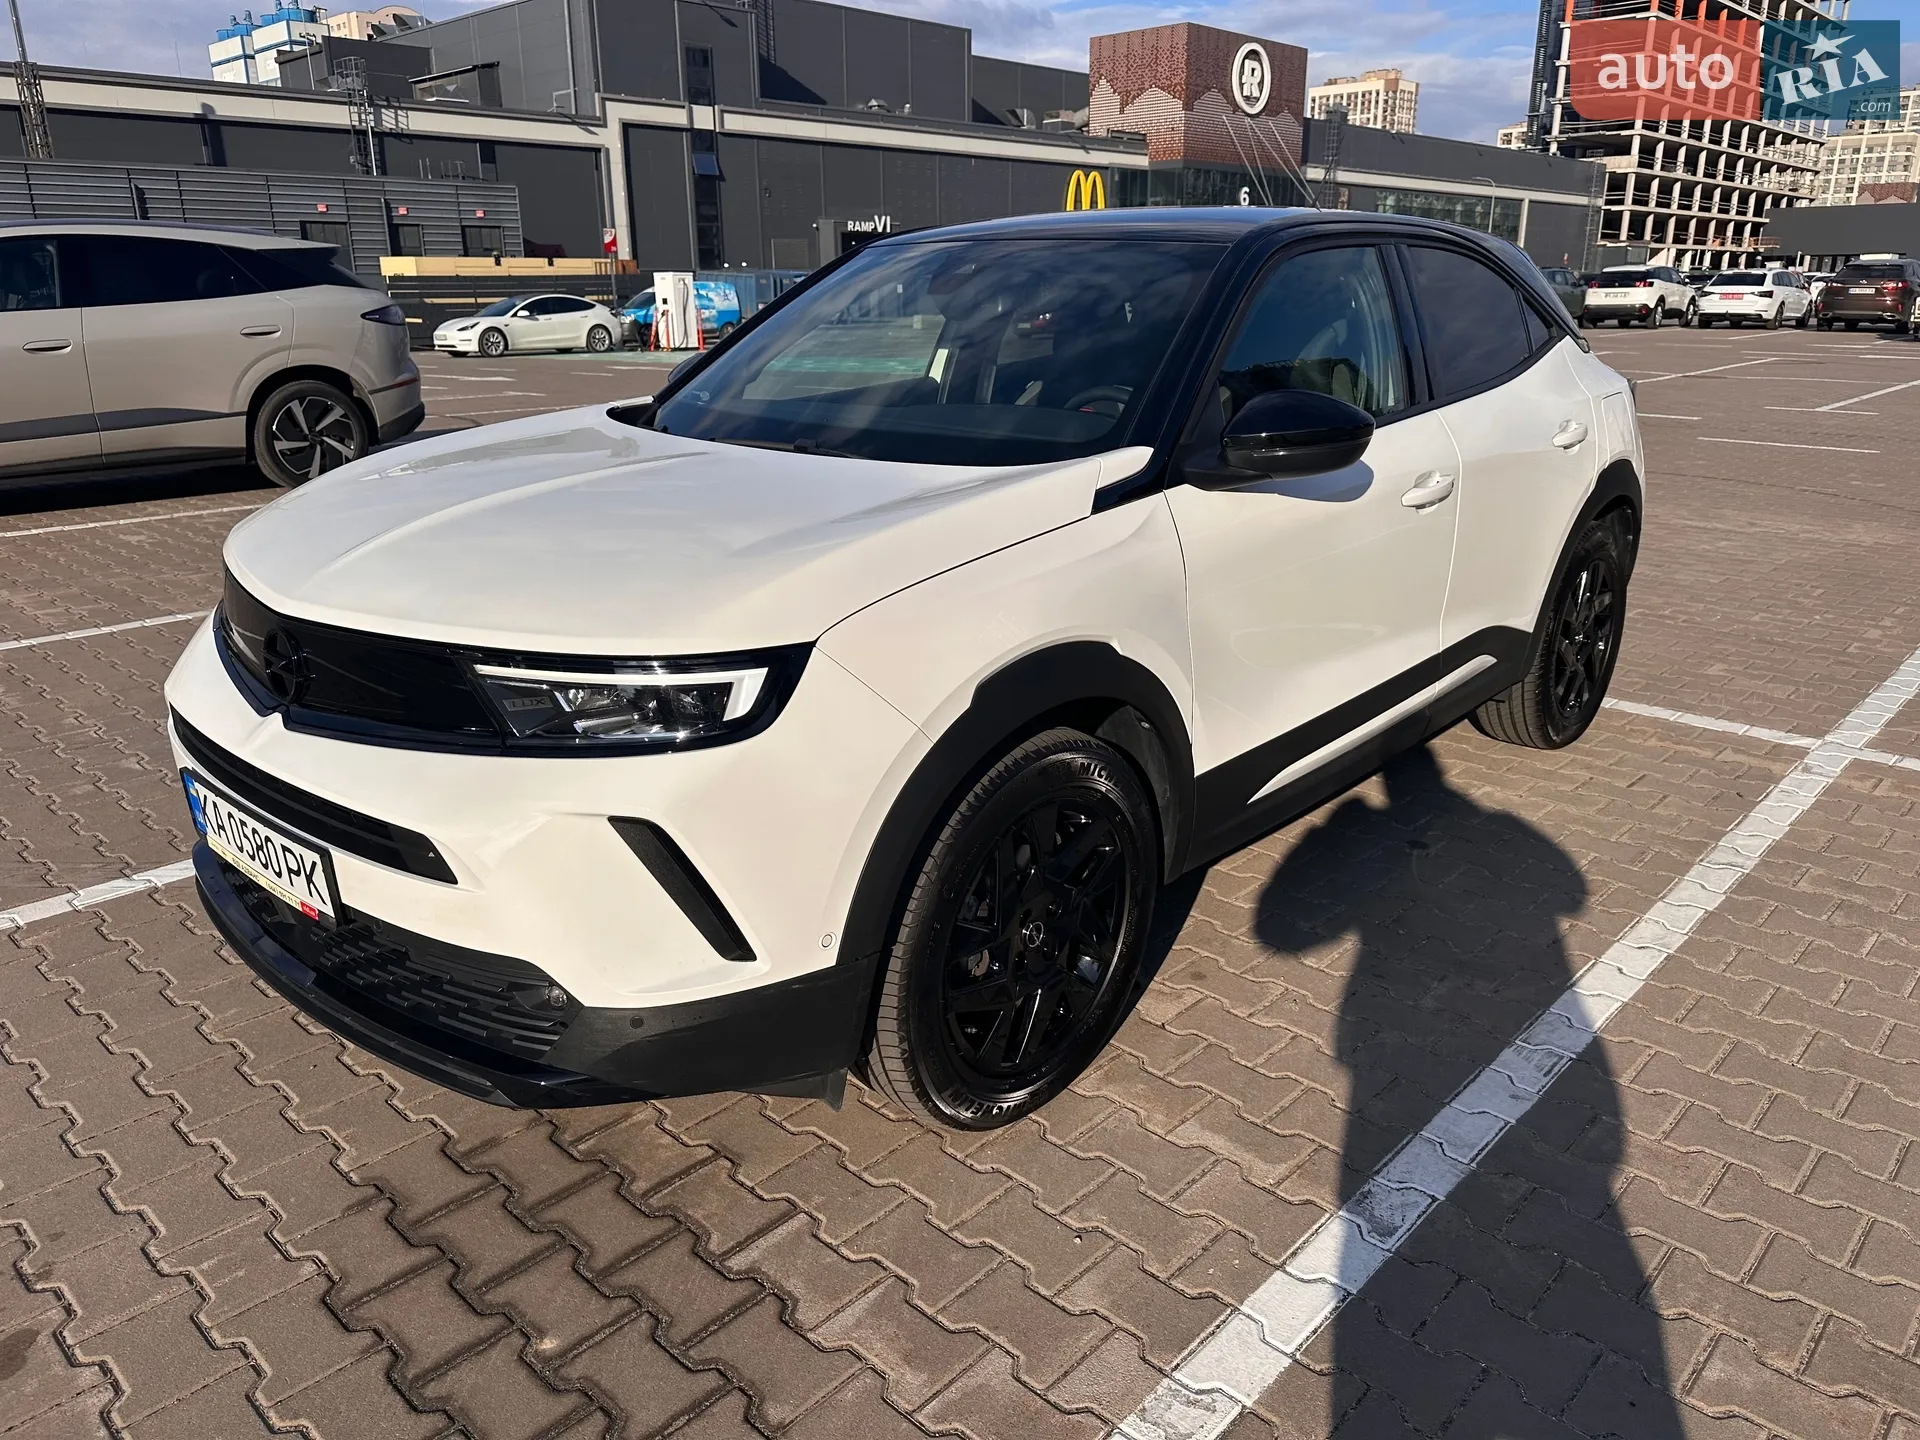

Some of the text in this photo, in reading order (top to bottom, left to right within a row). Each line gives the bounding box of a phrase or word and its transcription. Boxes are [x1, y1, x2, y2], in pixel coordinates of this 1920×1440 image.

[1240, 186, 1250, 206] 6
[847, 214, 891, 233] RAMP VI
